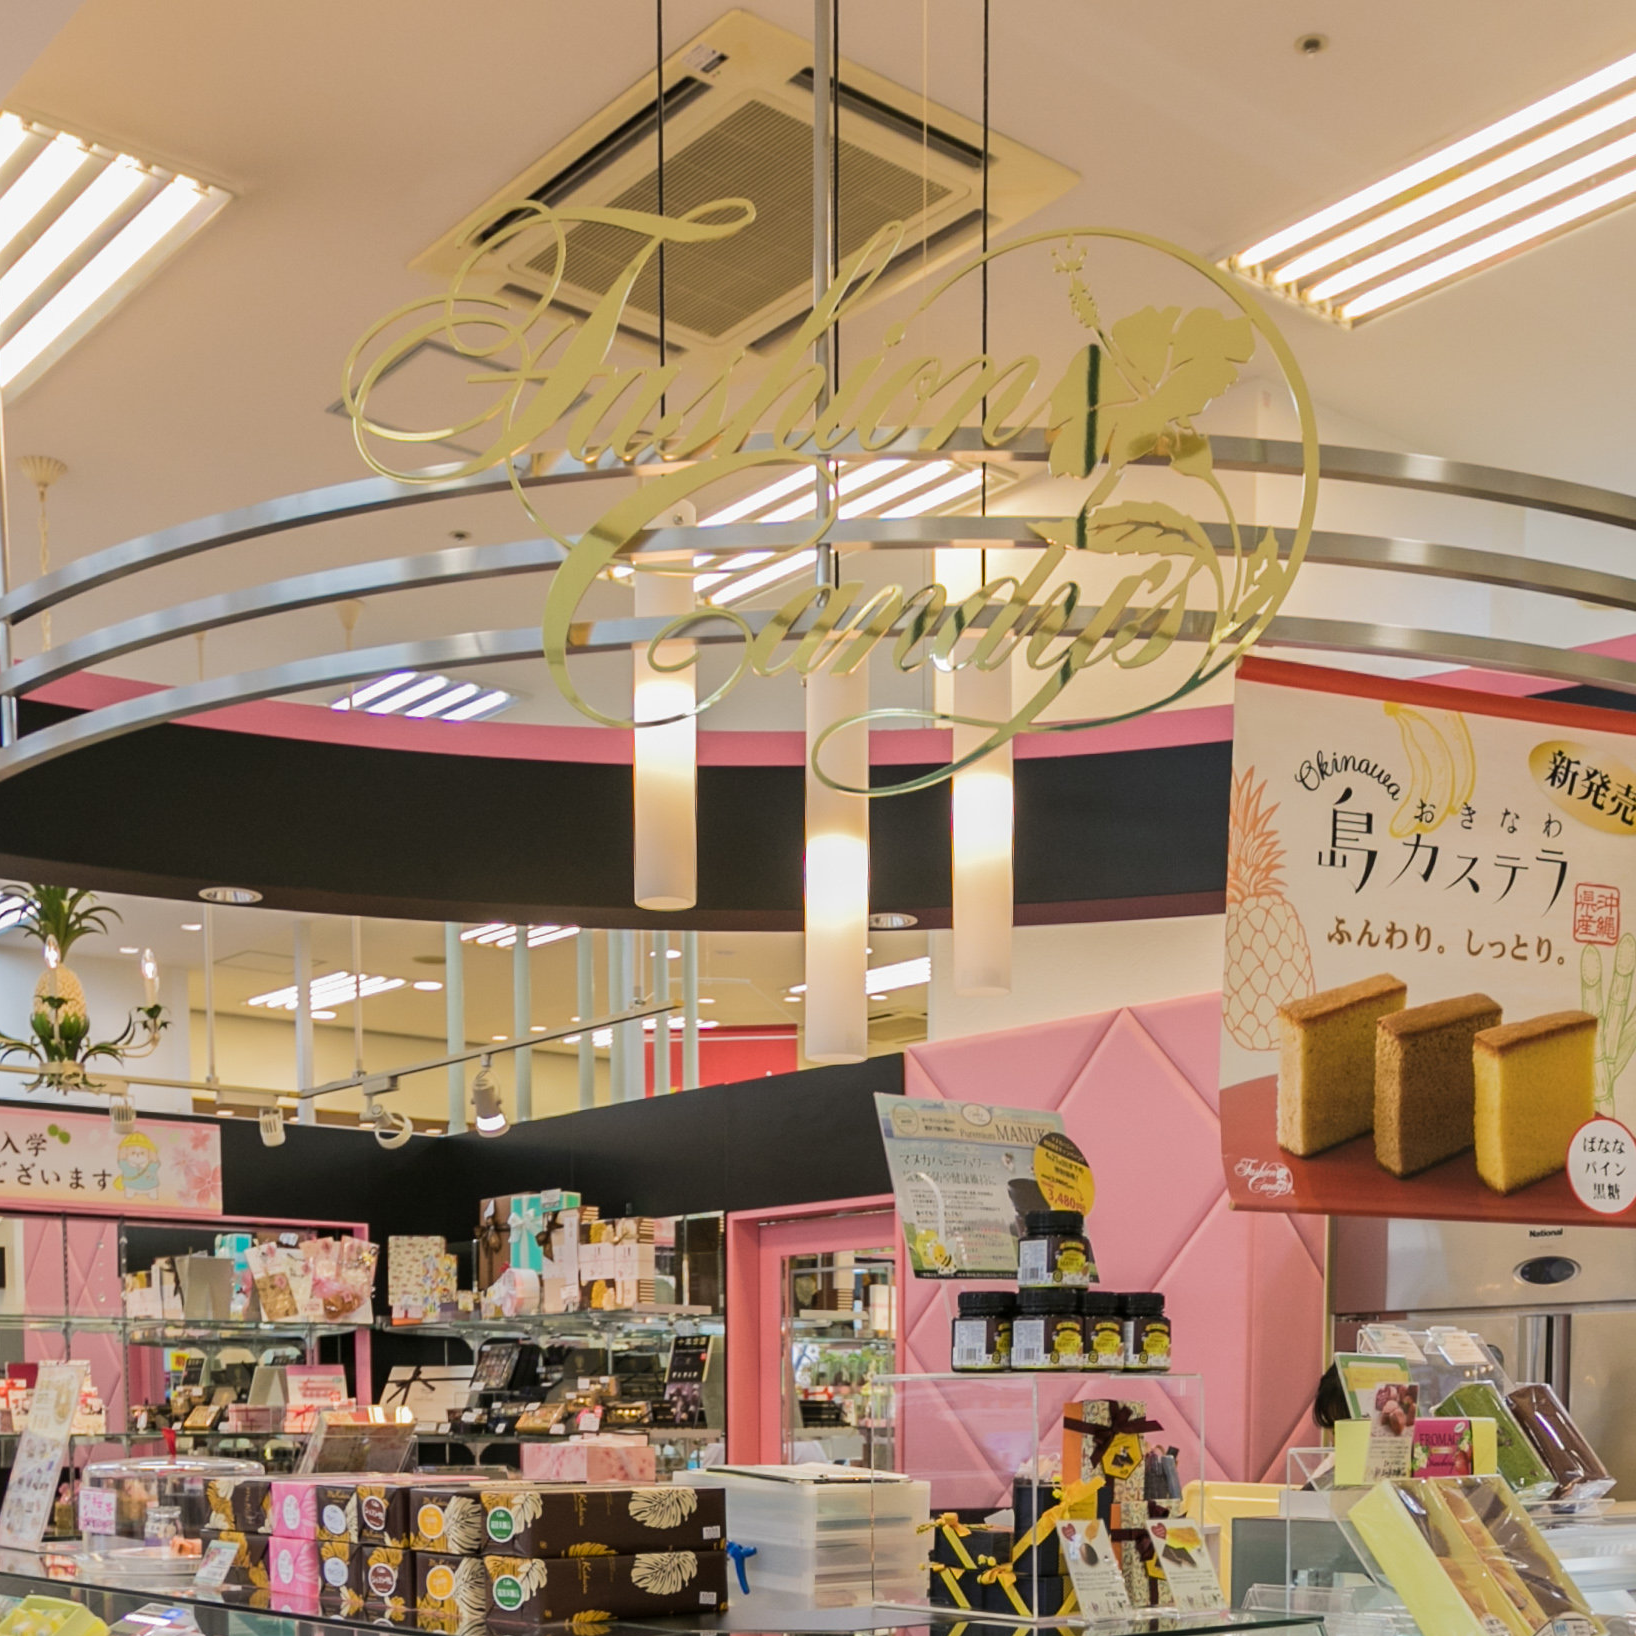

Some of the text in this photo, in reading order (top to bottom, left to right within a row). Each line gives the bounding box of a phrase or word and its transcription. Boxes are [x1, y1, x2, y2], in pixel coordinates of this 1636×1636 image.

[343, 198, 1056, 484] Fashion
[1294, 749, 1402, 802] Okinawa
[1414, 798, 1564, 840] おきなわ
[1318, 785, 1569, 919] 島カステラ
[995, 1124, 1054, 1146] MANUK
[1583, 1137, 1626, 1154] ばなな
[1585, 1161, 1627, 1177] パイン
[1593, 1182, 1621, 1200] 黒糖
[1529, 1228, 1564, 1238] National
